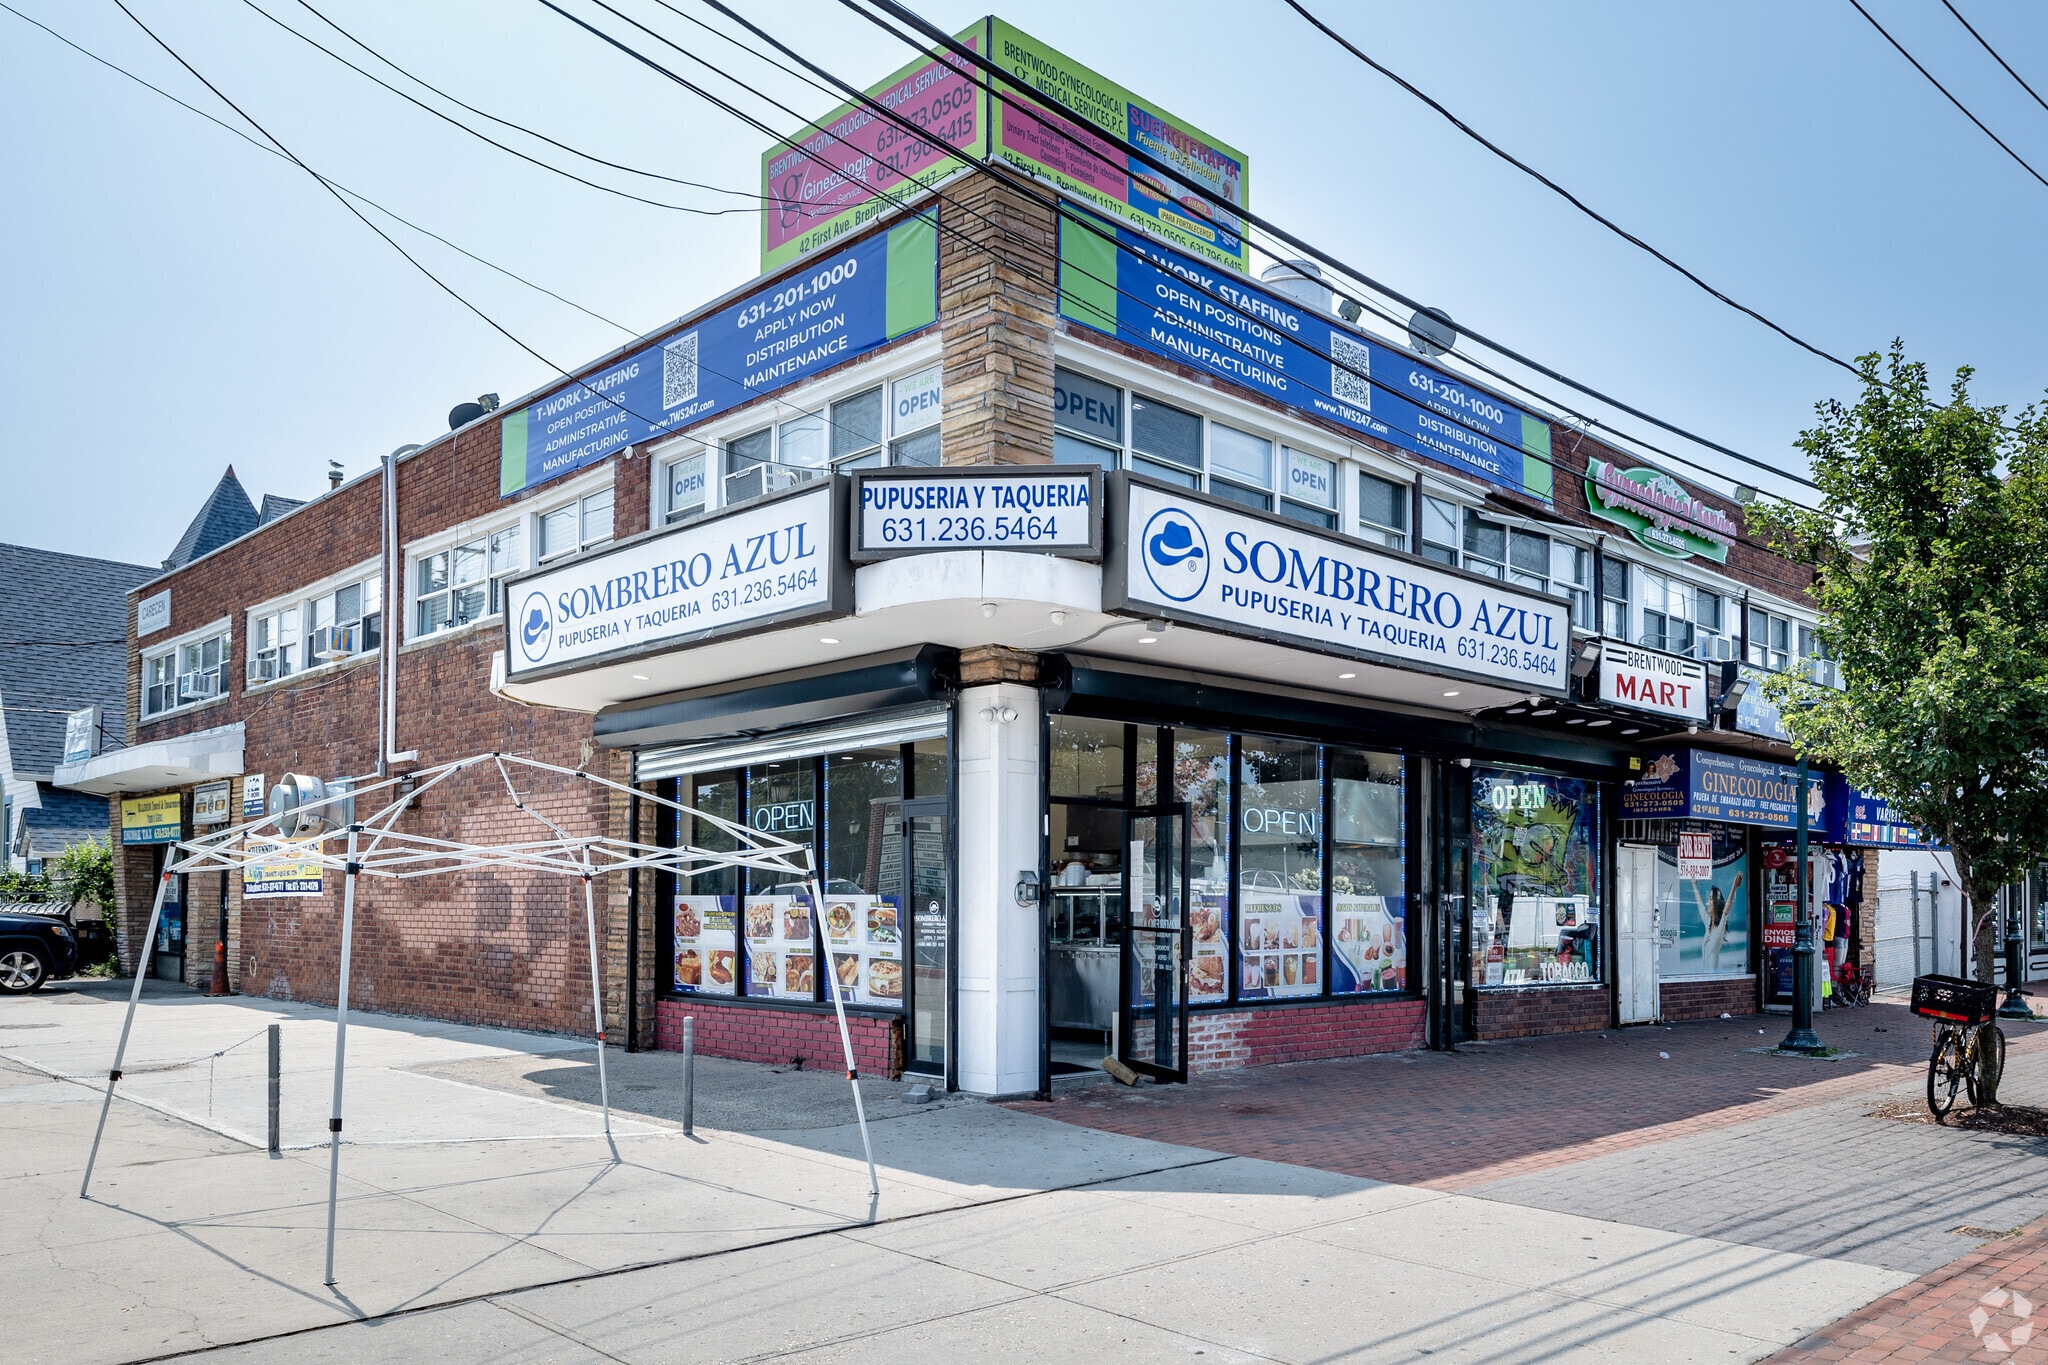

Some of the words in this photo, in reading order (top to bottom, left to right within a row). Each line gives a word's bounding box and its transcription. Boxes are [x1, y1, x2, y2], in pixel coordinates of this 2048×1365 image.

[1004, 41, 1058, 82] BRENTWOOD
[1060, 71, 1124, 118] GYNECOLOGICAL
[1035, 76, 1073, 108] MEDICAL
[1006, 120, 1026, 140] Urinary
[1130, 107, 1239, 181] SUEROTERAPIA
[1169, 150, 1179, 163] de
[800, 236, 810, 254] 42
[812, 227, 832, 247] First
[833, 220, 852, 238] Ave.
[737, 258, 858, 329] 631-201-1000
[1219, 284, 1300, 333] STAFFING
[754, 309, 797, 343] APPLY
[800, 294, 837, 324] NOW
[1155, 284, 1201, 313] OPEN
[1205, 300, 1282, 346] POSITIONS
[746, 313, 846, 368] DISTRIBUTION
[1153, 306, 1285, 369] ADMINISTRATIVE
[743, 335, 849, 391] MAINTENANCE
[1150, 327, 1287, 392] MANUFACTURING
[537, 385, 581, 422] T-WORK
[583, 362, 640, 401] STAFFING
[899, 386, 940, 417] OPEN
[1054, 387, 1116, 428] OPEN
[1408, 369, 1504, 425] 631-201-1000
[547, 413, 572, 434] OPEN
[575, 391, 627, 425] POSITIONS
[649, 399, 715, 433] www.TWS247.com
[1313, 398, 1388, 435] www.TWS247.com
[1463, 414, 1490, 435] NOW
[544, 410, 628, 454] ADMINISTRATIVE
[1418, 414, 1498, 457] DISTRIBUTION
[543, 428, 629, 473] MANUFACTURING
[1416, 433, 1500, 475] MAINTENANCE
[675, 472, 705, 496] OPEN
[1291, 467, 1326, 492] OPEN
[1600, 462, 1695, 529] Gynecological
[864, 486, 969, 510] PUPUSERIA
[974, 485, 986, 509] Y
[992, 484, 1089, 513] TAQUERIA
[882, 516, 1057, 542] 631.236.5464
[558, 552, 712, 624] SOMBRERO
[720, 522, 816, 580] AZUL
[558, 621, 620, 649] PUPUSERIA
[624, 618, 632, 633] Y
[636, 602, 701, 628] TAQUERIA
[711, 566, 818, 612] 631.236.5464
[1223, 531, 1462, 630] SOMBRERO
[1469, 597, 1560, 651] AZUL
[1221, 584, 1333, 628] PUPUSERIA
[1340, 611, 1352, 631] Y
[1358, 617, 1446, 654] TAQUERIA
[1457, 636, 1557, 677] 631.236.5464
[1627, 651, 1683, 677] BRENTWOOD
[1615, 672, 1691, 709] MART
[1695, 752, 1734, 769] Comprehensive
[1739, 760, 1774, 777] Gynecological
[1491, 785, 1546, 810] OPEN
[1623, 791, 1684, 802] GINECOLOGIA
[1624, 800, 1684, 808] 631-273-0505
[1693, 791, 1709, 801] PRUEBA
[1711, 793, 1717, 803] DE
[1720, 795, 1741, 806] EMBARAZO
[1742, 797, 1756, 808] GRATIS
[1760, 800, 1769, 810] FREE
[1769, 801, 1790, 812] PREGNANCY
[1790, 804, 1798, 813] TES
[1702, 771, 1797, 803] GINECOLOGIA
[755, 800, 814, 831] OPEN
[1243, 808, 1315, 835] OPEN
[1728, 809, 1789, 822] 631-273-0505
[1680, 835, 1693, 858] FOR
[1693, 835, 1711, 858] RENT
[1245, 903, 1282, 913] REFRESCOS
[1336, 903, 1352, 912] JUGOS
[1503, 969, 1526, 985] ATM
[1540, 961, 1590, 983] TOBACCO
